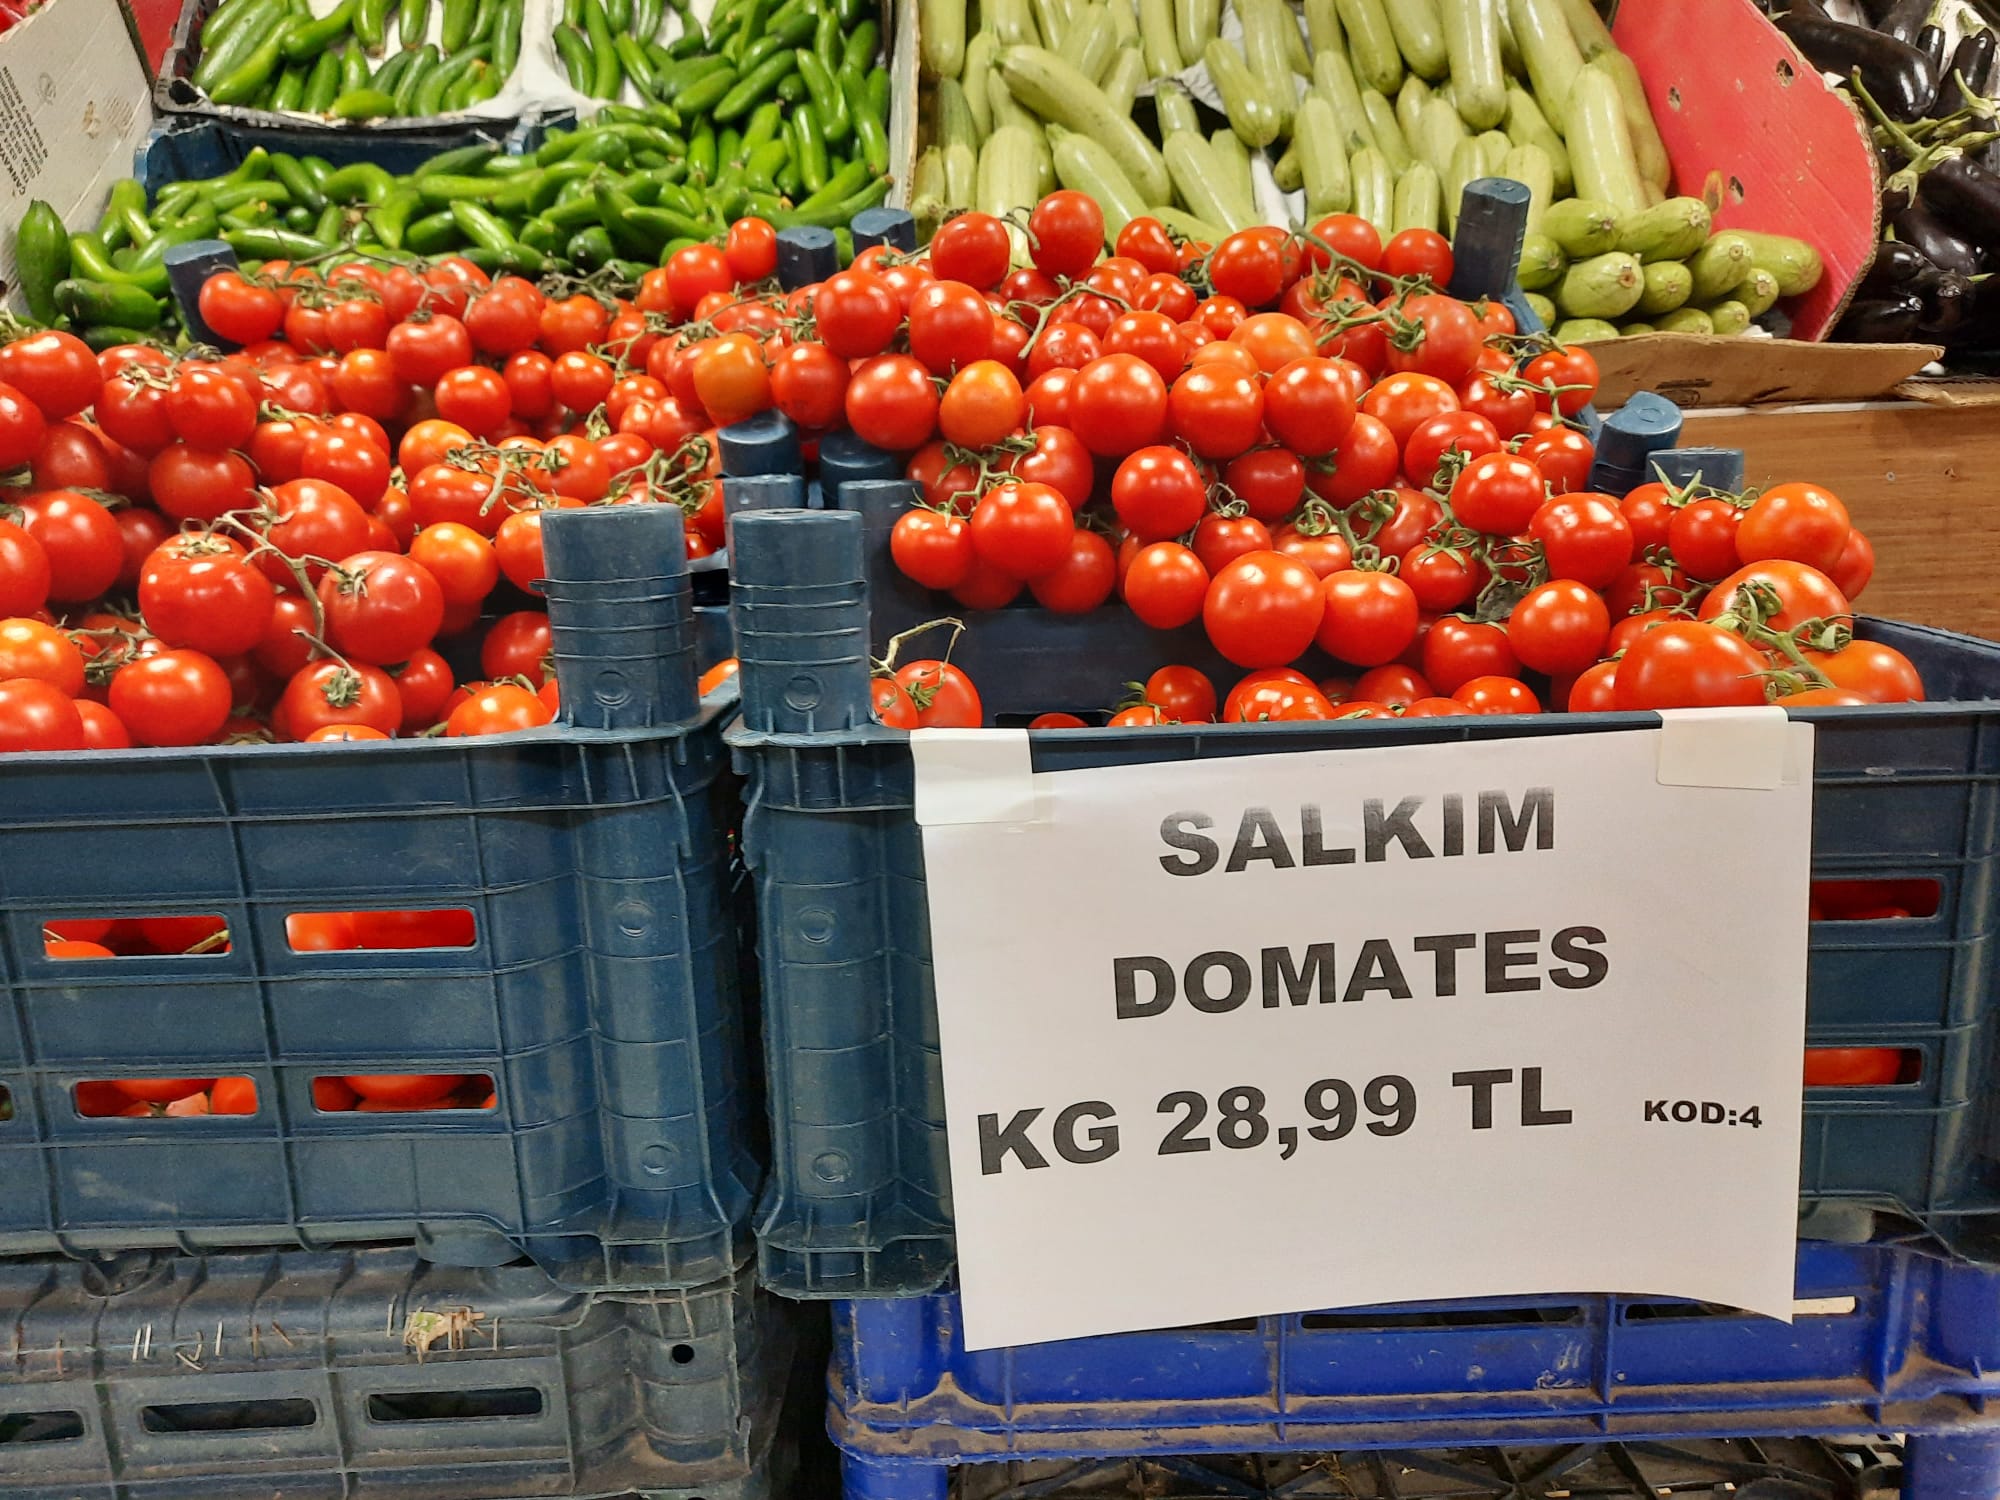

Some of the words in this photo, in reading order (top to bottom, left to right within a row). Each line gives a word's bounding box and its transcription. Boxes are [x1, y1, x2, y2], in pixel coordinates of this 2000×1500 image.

[1159, 786, 1555, 876] SALKIM
[1114, 925, 1609, 1020] DOMATES
[977, 1100, 1120, 1176] KG
[1156, 1074, 1417, 1161] 28,99
[1451, 1066, 1573, 1130] TL
[1643, 1098, 1764, 1130] KOD:4
